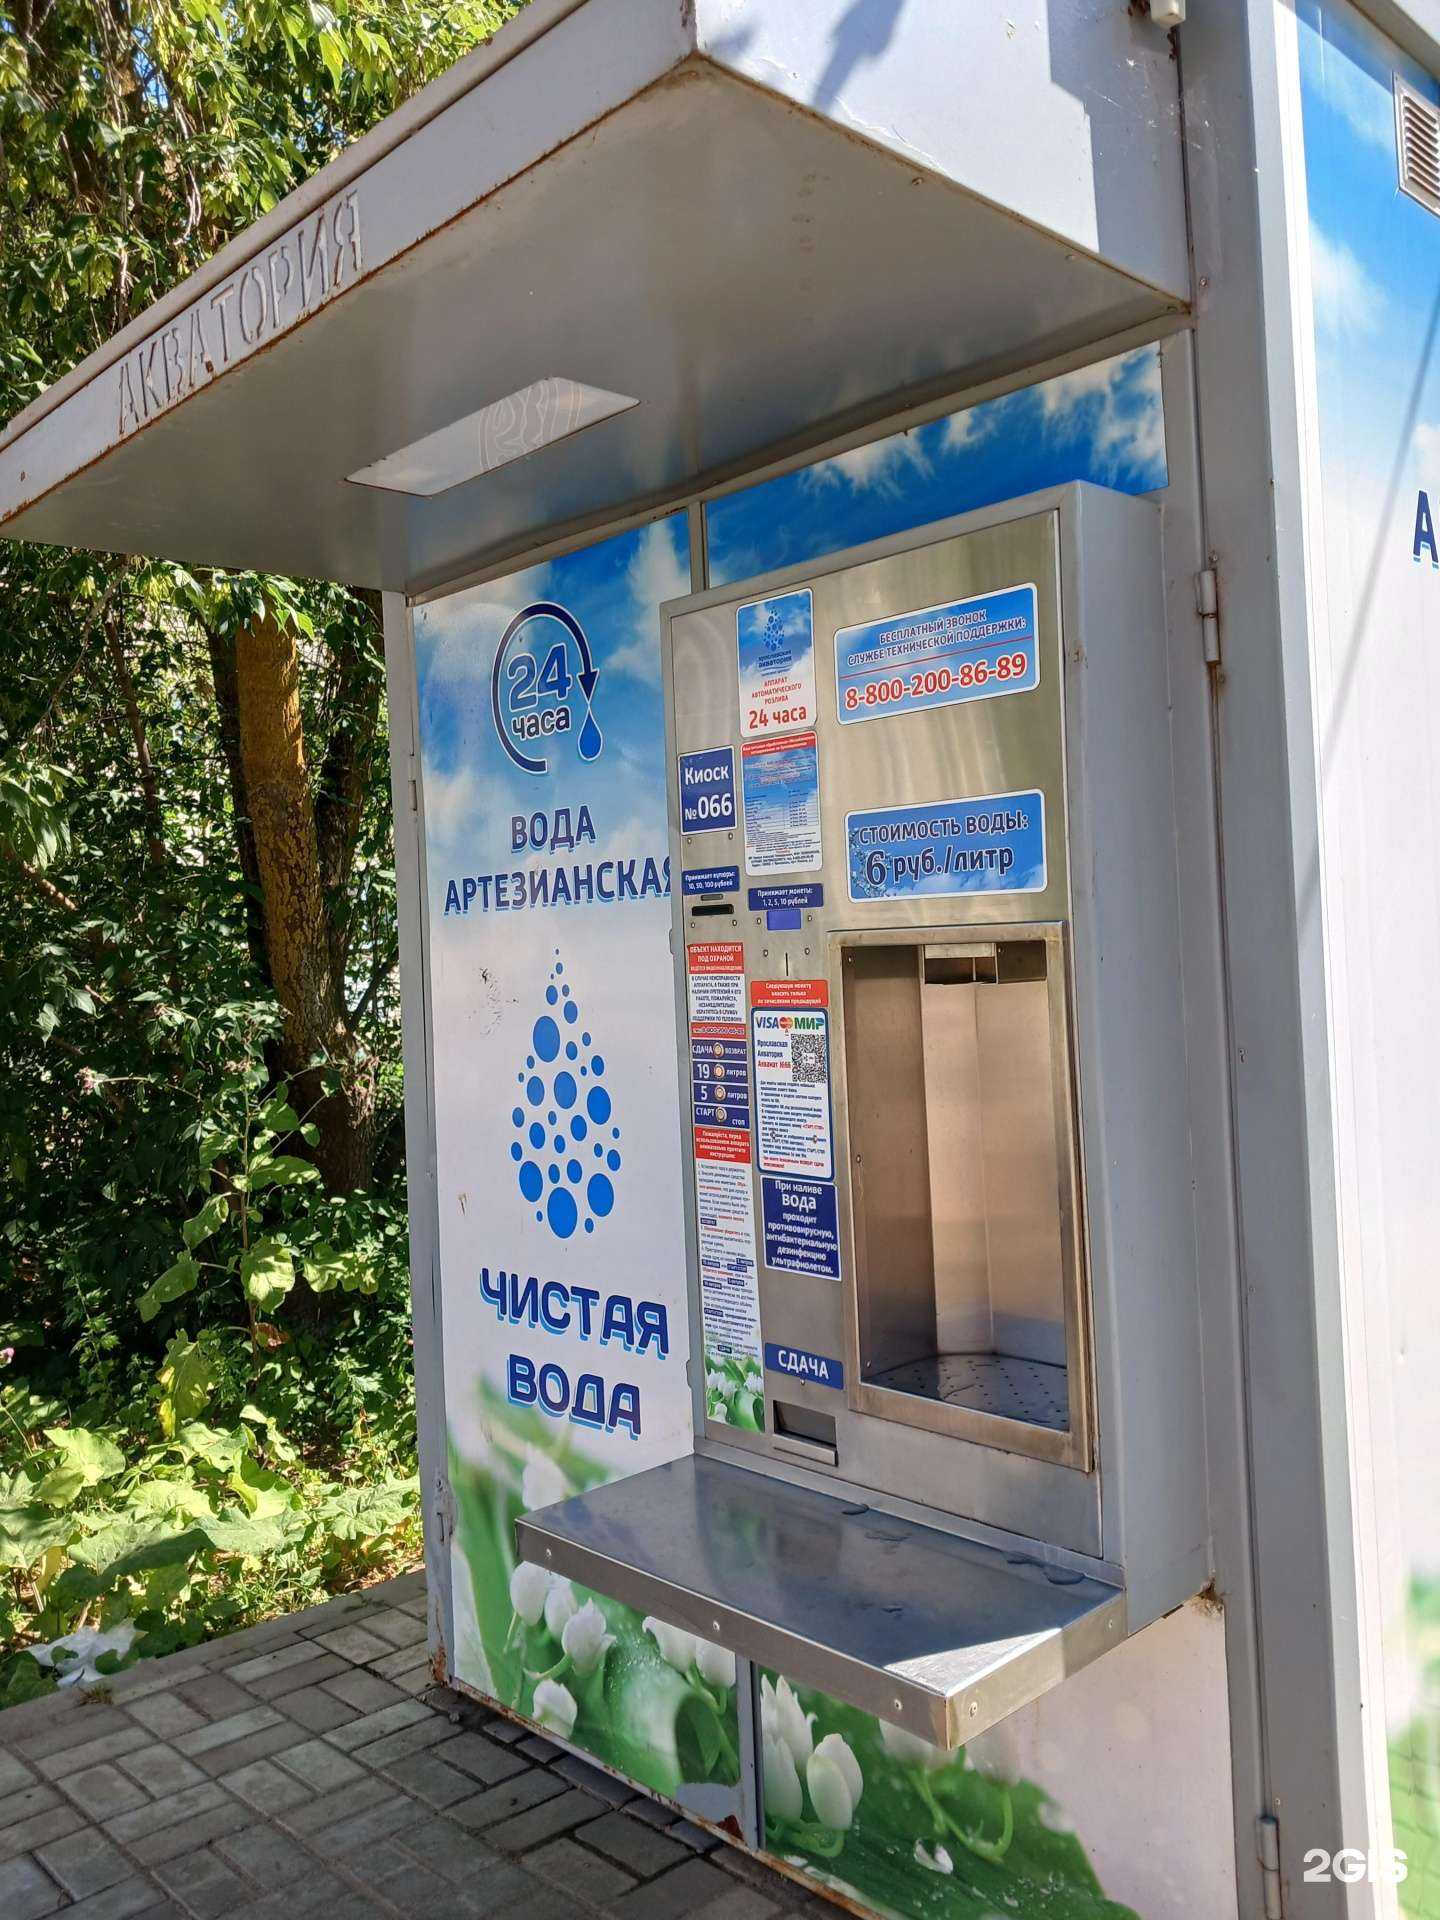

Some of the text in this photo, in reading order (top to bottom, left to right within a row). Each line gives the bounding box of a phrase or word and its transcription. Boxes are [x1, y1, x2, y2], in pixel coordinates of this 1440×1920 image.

[117, 189, 363, 434] АКВАТОРИЯ
[848, 616, 1027, 666] СЛУЖБЕ ТЕХНИЧЕСКОЙ ПОДДЕРЖКИ:
[879, 609, 987, 645] БЕСПЛАТНЫЙ ЗВОНОК
[507, 643, 573, 712] 24
[844, 652, 1027, 710] 8-800-200-86-89
[511, 706, 570, 741] часа
[749, 706, 807, 730] 24 часа
[684, 765, 730, 786] Киоск
[511, 804, 597, 854] ВОДА
[859, 810, 1029, 846] СТОИМОСТЬ ВОДЫ:
[866, 845, 1015, 887] 6 руб./литр
[756, 1016, 779, 1029] VISA
[794, 1017, 825, 1030] МИР
[693, 1045, 713, 1054] СДАЧА
[697, 1063, 747, 1079] 19 литров
[701, 1086, 708, 1101] 5
[727, 1091, 748, 1100] литров
[695, 1107, 715, 1116] СТАРТ
[775, 1180, 823, 1195] При наливе
[782, 1212, 817, 1225] проходит
[777, 1246, 827, 1261] дезинфекцию
[480, 1267, 669, 1360] ЧИСТАЯ
[778, 1349, 830, 1380] СДАЧА
[506, 1354, 641, 1441] ВОДА
